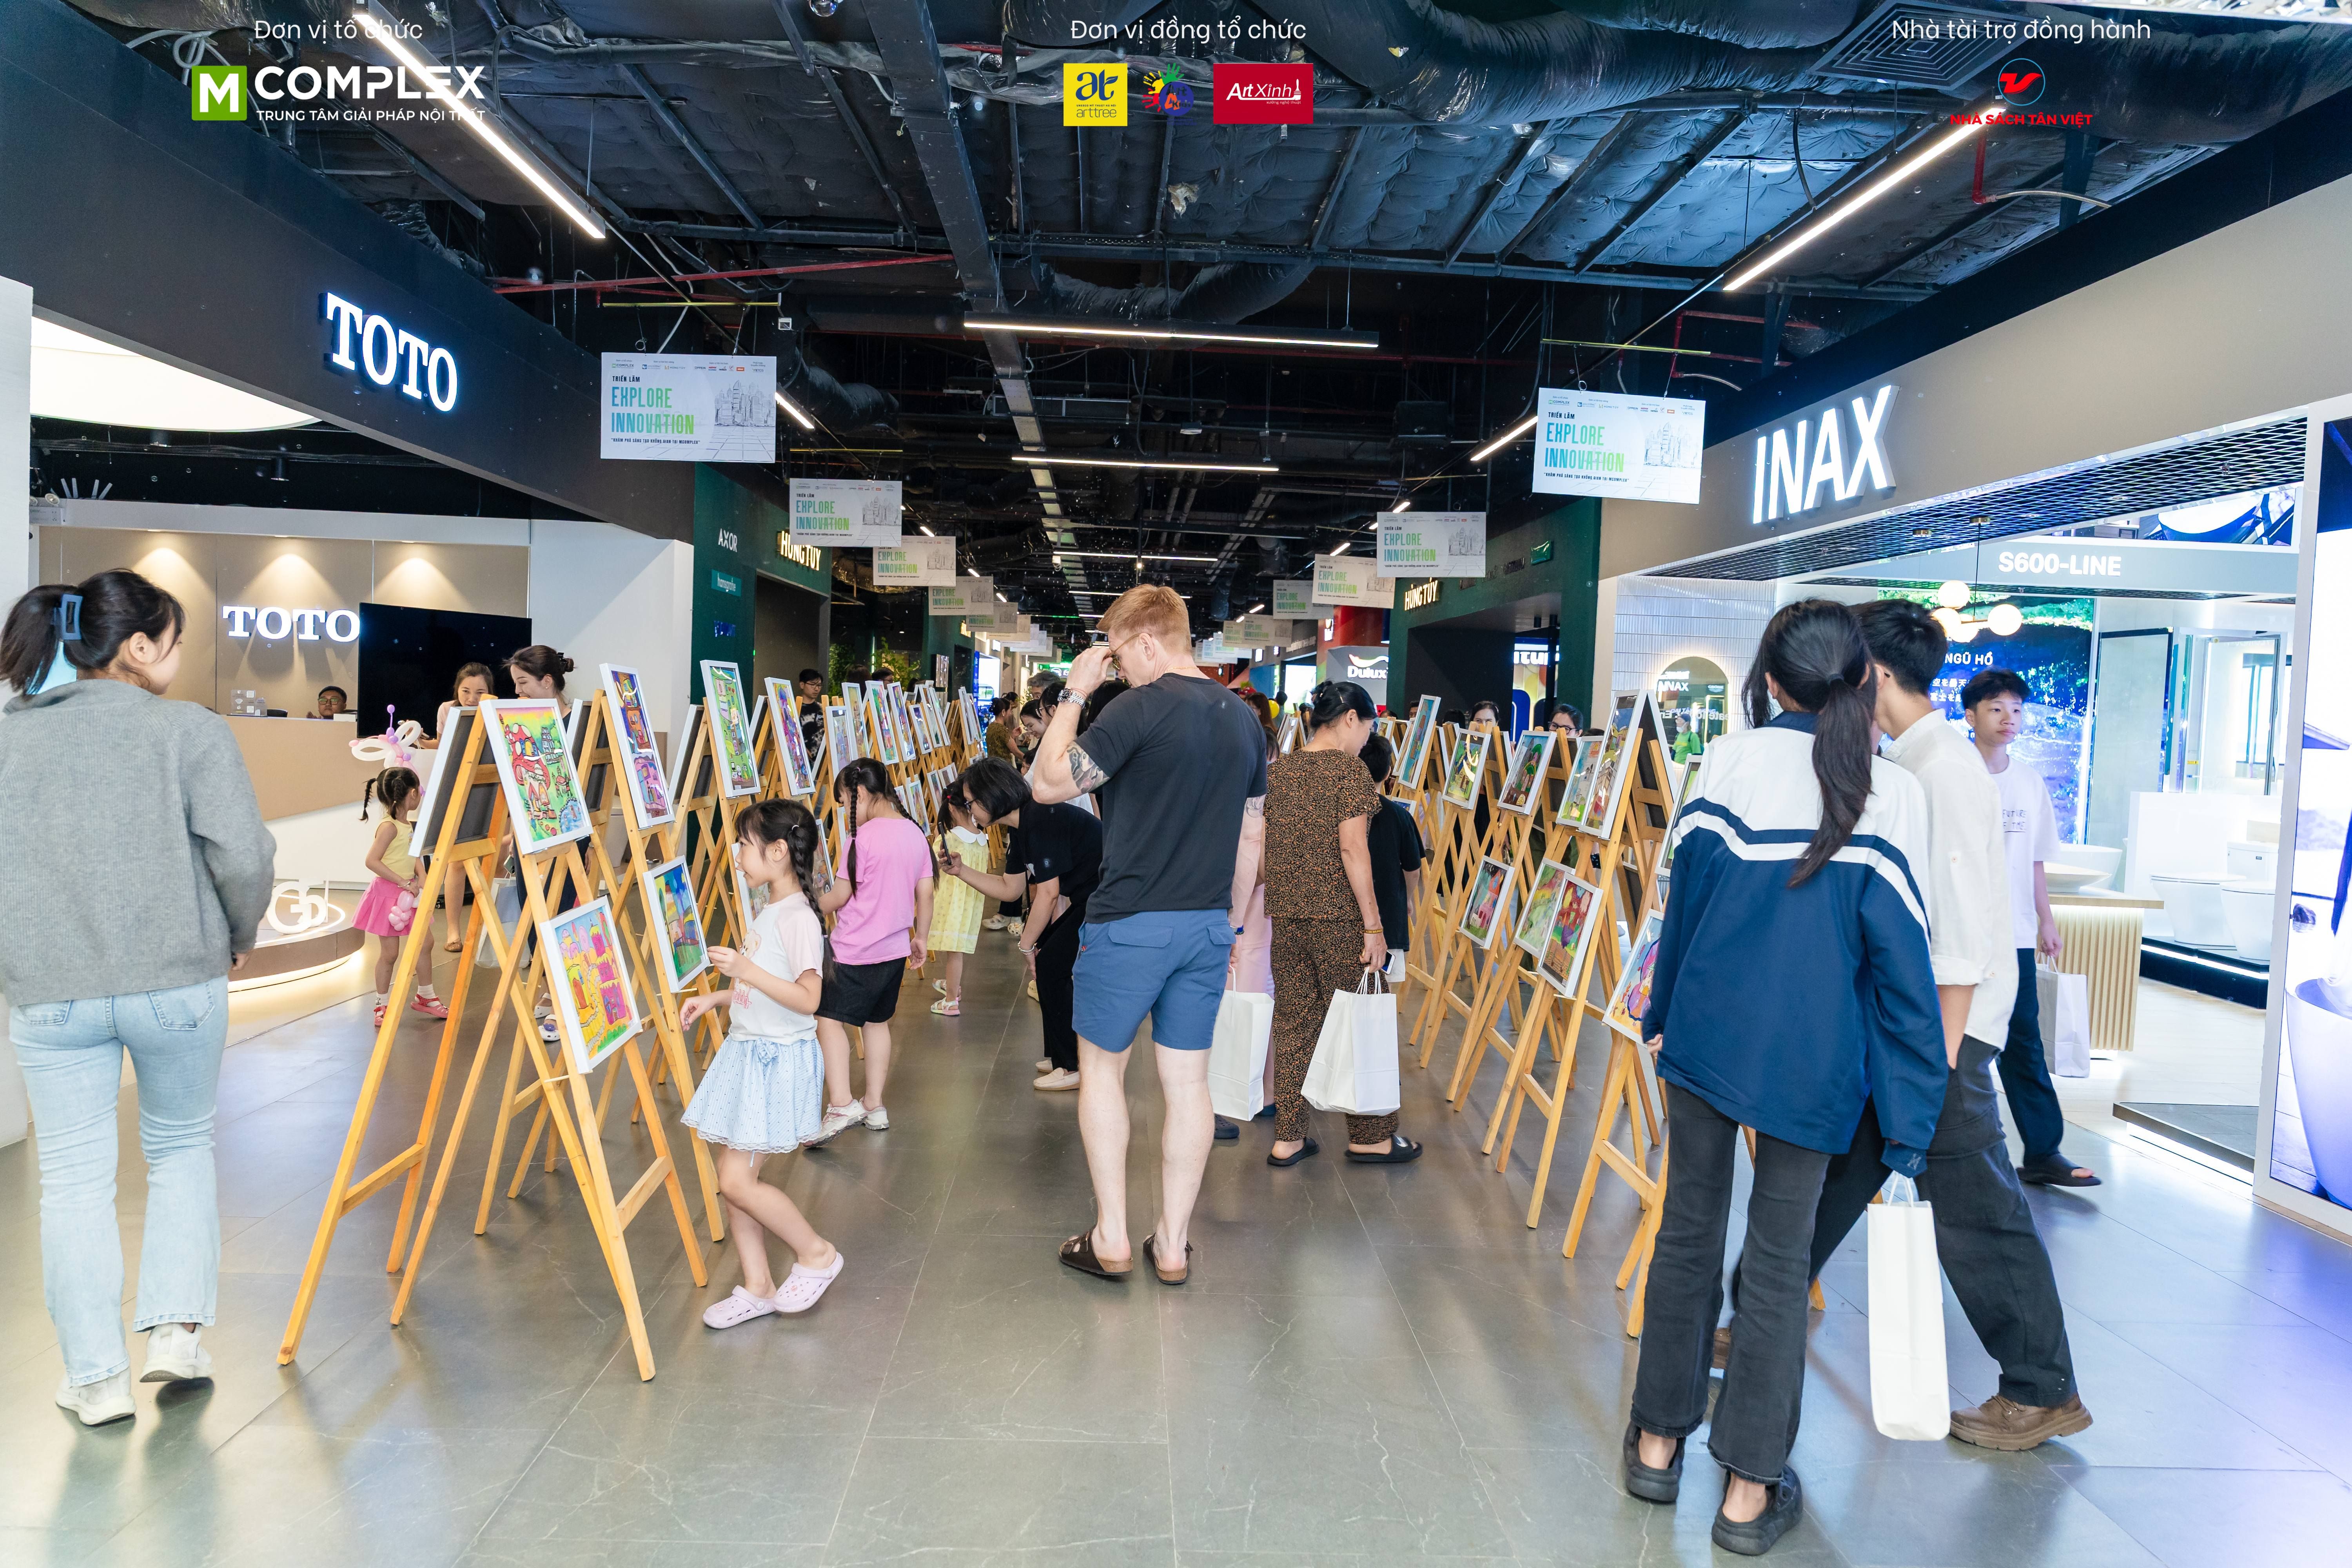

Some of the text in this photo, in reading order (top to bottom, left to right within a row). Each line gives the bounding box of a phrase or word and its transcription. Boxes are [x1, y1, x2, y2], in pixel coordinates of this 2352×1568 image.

[327, 292, 458, 412] TOTO
[612, 387, 672, 408] EXPLORE
[611, 412, 694, 435] INNOVATION
[1546, 422, 1605, 446] EXPLORE
[1544, 447, 1624, 473] INNOVATION
[1753, 385, 1896, 524] INAX
[796, 500, 835, 514] EXPLORE
[796, 517, 849, 530] INNOVATION
[718, 528, 737, 552] AXOR
[1384, 533, 1422, 546] EXPLORE
[878, 552, 907, 561] EXPLORE
[1384, 549, 1436, 562] INNOVATION
[878, 563, 917, 573] INNOVATION
[1998, 552, 2122, 577] S600-LINE
[1319, 570, 1347, 581] EXPLORE
[1318, 582, 1357, 594] INNOVATION
[223, 606, 360, 642] TOTO
[1347, 666, 1387, 679] Dulux
